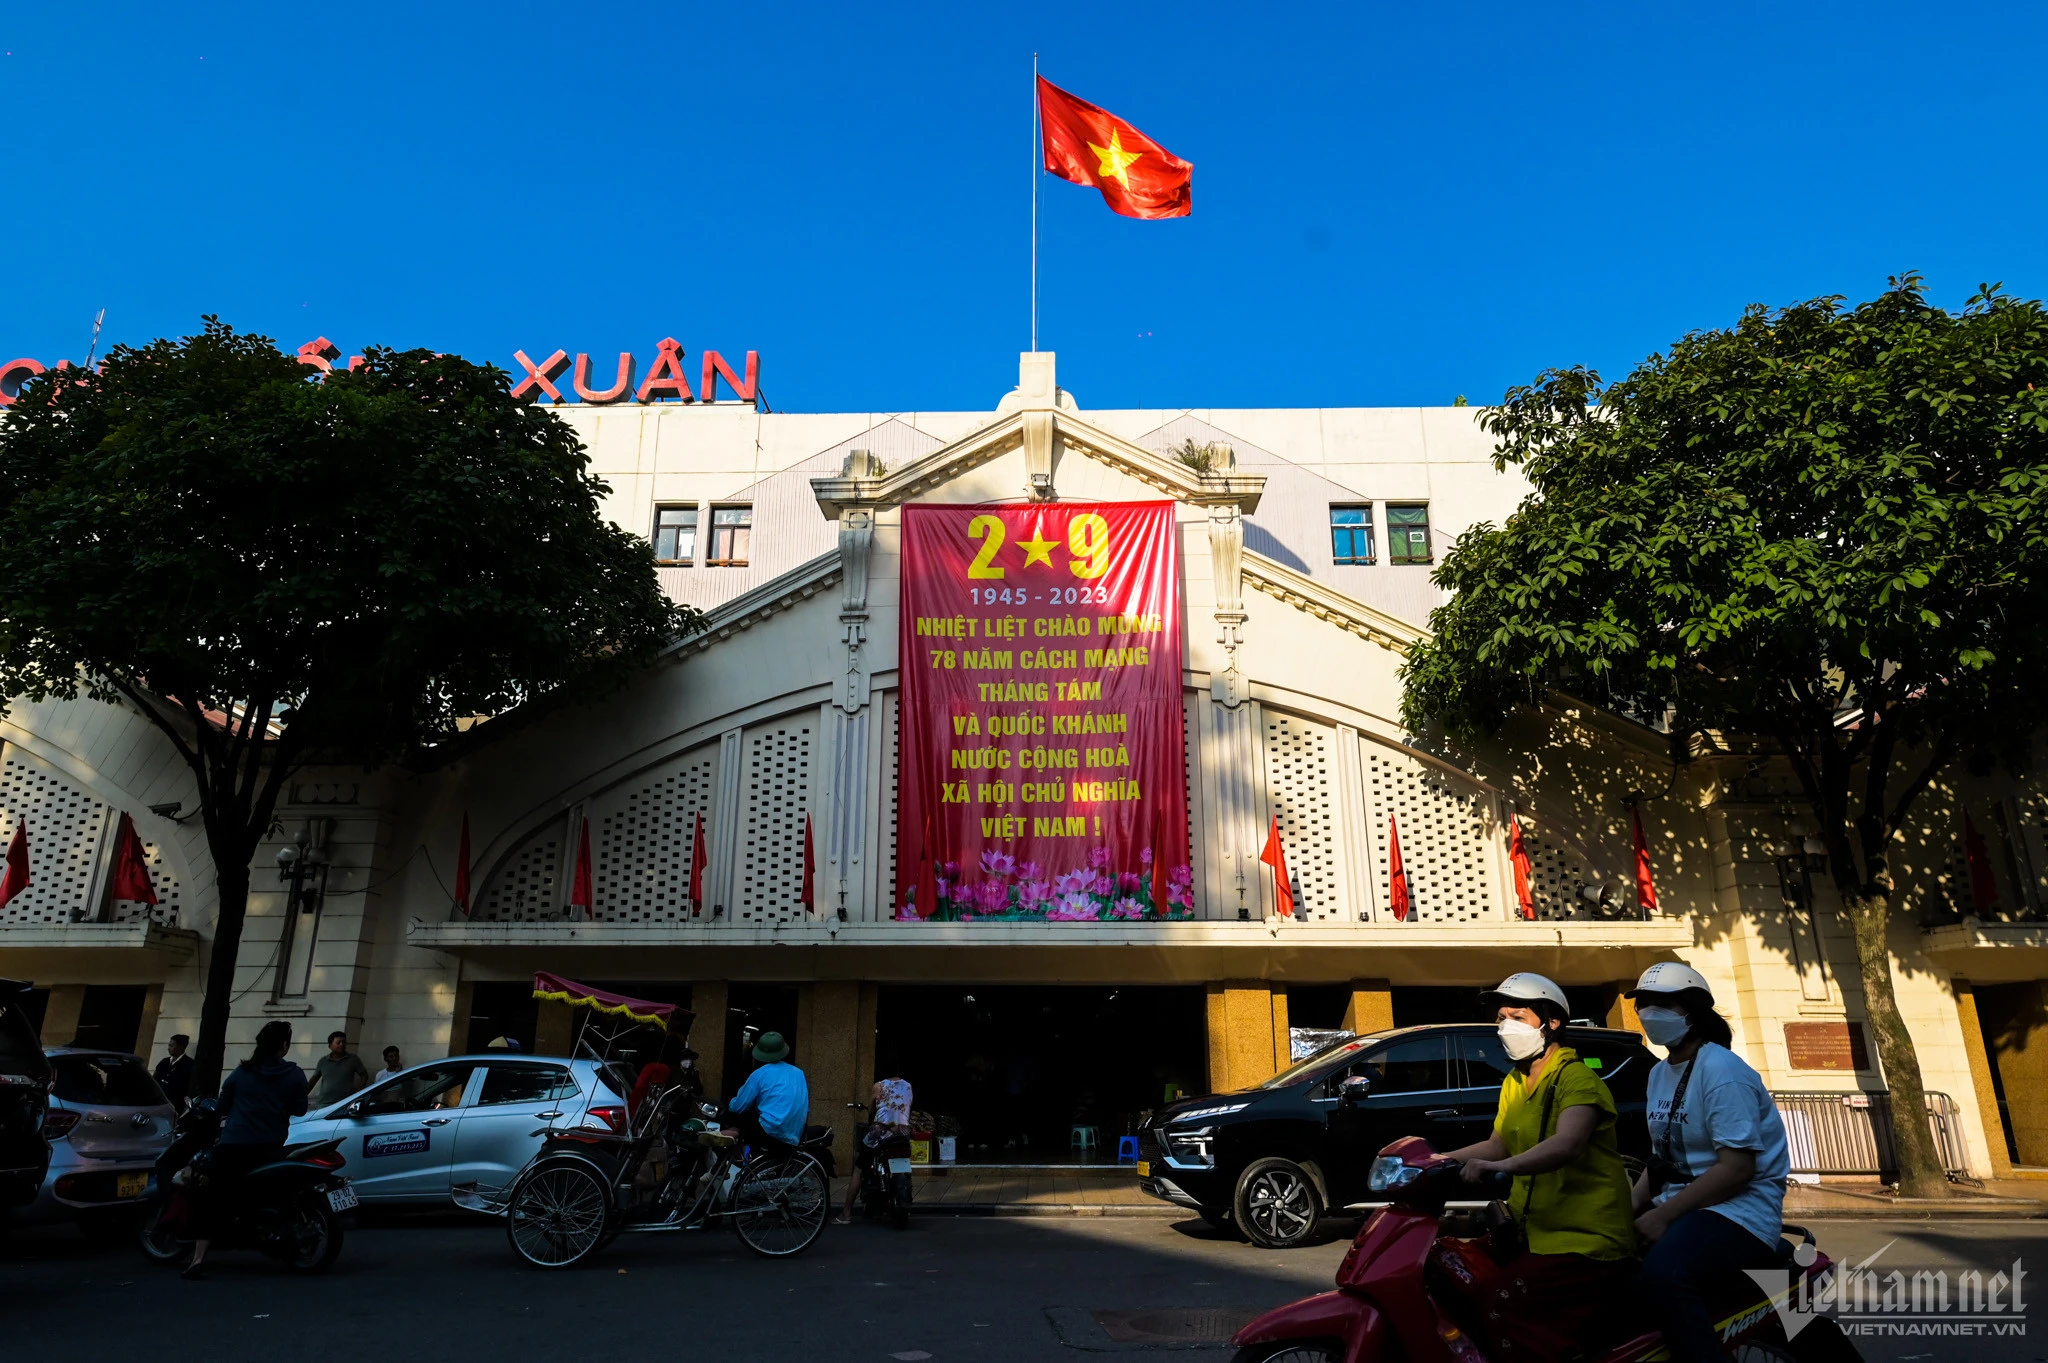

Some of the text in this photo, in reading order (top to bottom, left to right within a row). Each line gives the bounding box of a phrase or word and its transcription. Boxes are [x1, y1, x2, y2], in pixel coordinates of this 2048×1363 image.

[510, 336, 761, 403] XUÂN
[967, 513, 1109, 580] 2 9
[970, 588, 1027, 606] 1945
[1049, 586, 1109, 605] 2023
[917, 614, 978, 641] NHIỆT
[985, 614, 1028, 641] LIỆT
[1034, 613, 1091, 637] CHÀO
[930, 646, 1149, 671] 78 NĂM CÁCH MẠNG
[978, 678, 1102, 703] THÁNG TÁM
[952, 709, 1127, 738] VÀ QUỐC KHÁNH
[951, 743, 1131, 773] NƯỚC CỘNG HOÀ
[941, 776, 1142, 808] XÃ HỘI CHỦ NGHĨA
[981, 814, 1101, 842] VIỆT NAM !
